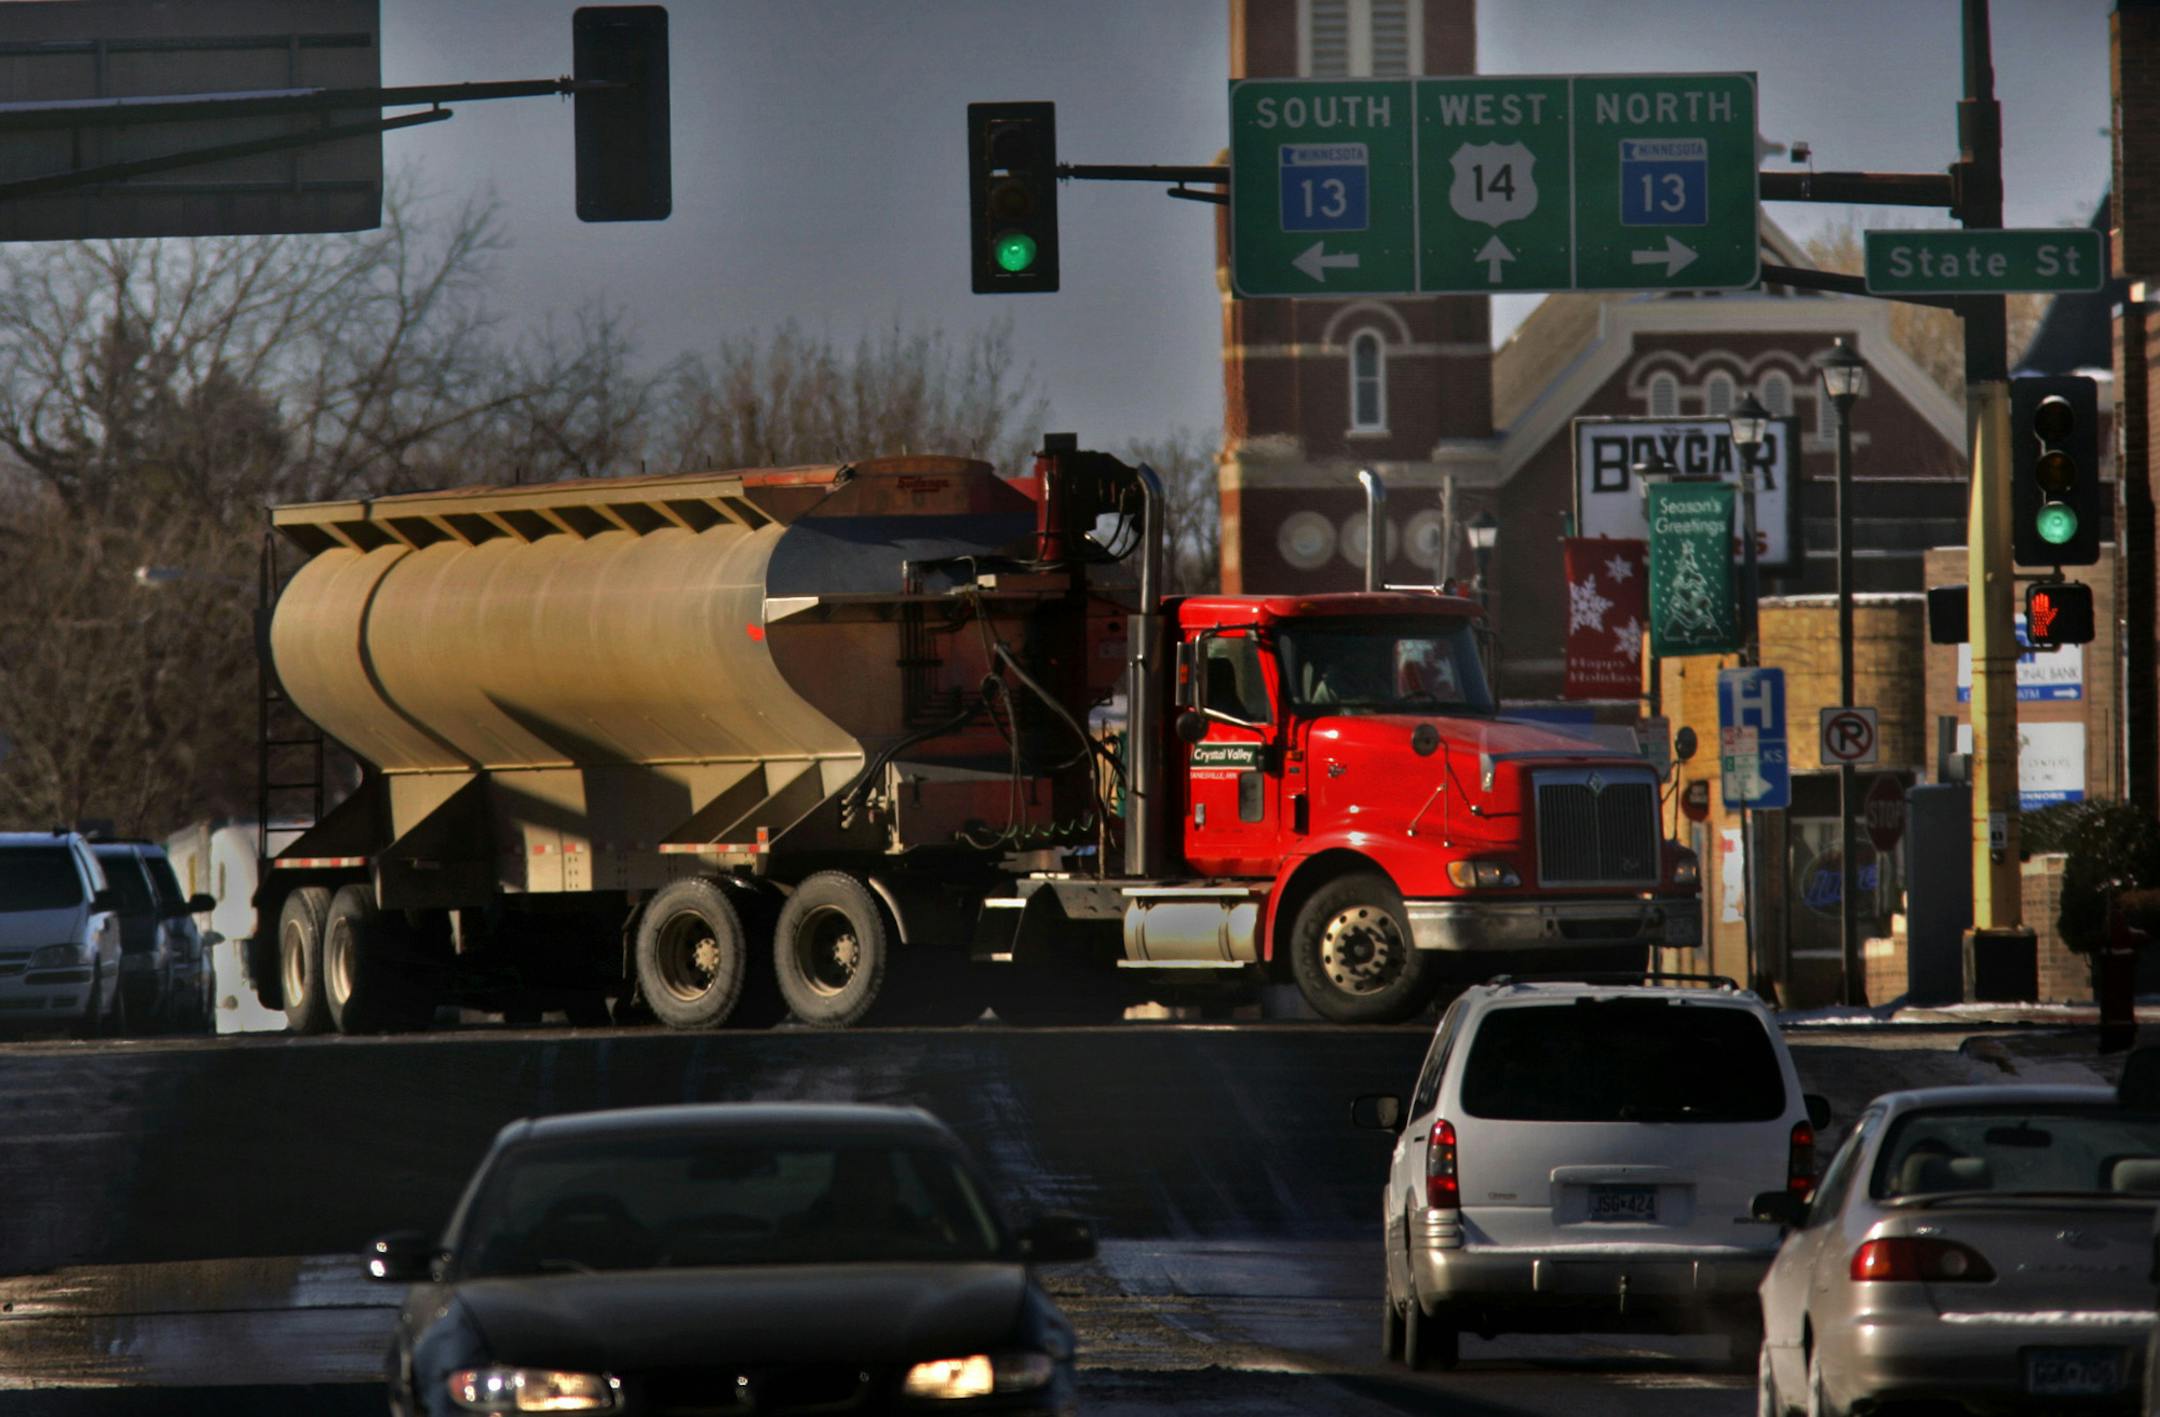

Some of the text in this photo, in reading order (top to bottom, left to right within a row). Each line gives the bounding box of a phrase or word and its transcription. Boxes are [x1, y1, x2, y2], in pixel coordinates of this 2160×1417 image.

[1256, 96, 1391, 129] SOUTH
[1439, 94, 1548, 126] WEST
[1596, 91, 1732, 125] NORTH
[1298, 149, 1364, 161] MINNESOTA
[1638, 143, 1704, 156] MINNESOTA
[1301, 178, 1347, 217] 13
[1472, 163, 1515, 201] 14
[1640, 173, 1686, 213] 13
[1888, 244, 2081, 278] State St
[1592, 433, 1777, 493] BOXCAR
[1659, 496, 1723, 514] Season's
[1655, 516, 1727, 538] Greetings
[1731, 679, 1773, 729] H
[1193, 748, 1254, 763] Crystal Valley
[1869, 800, 1905, 829] STOP
